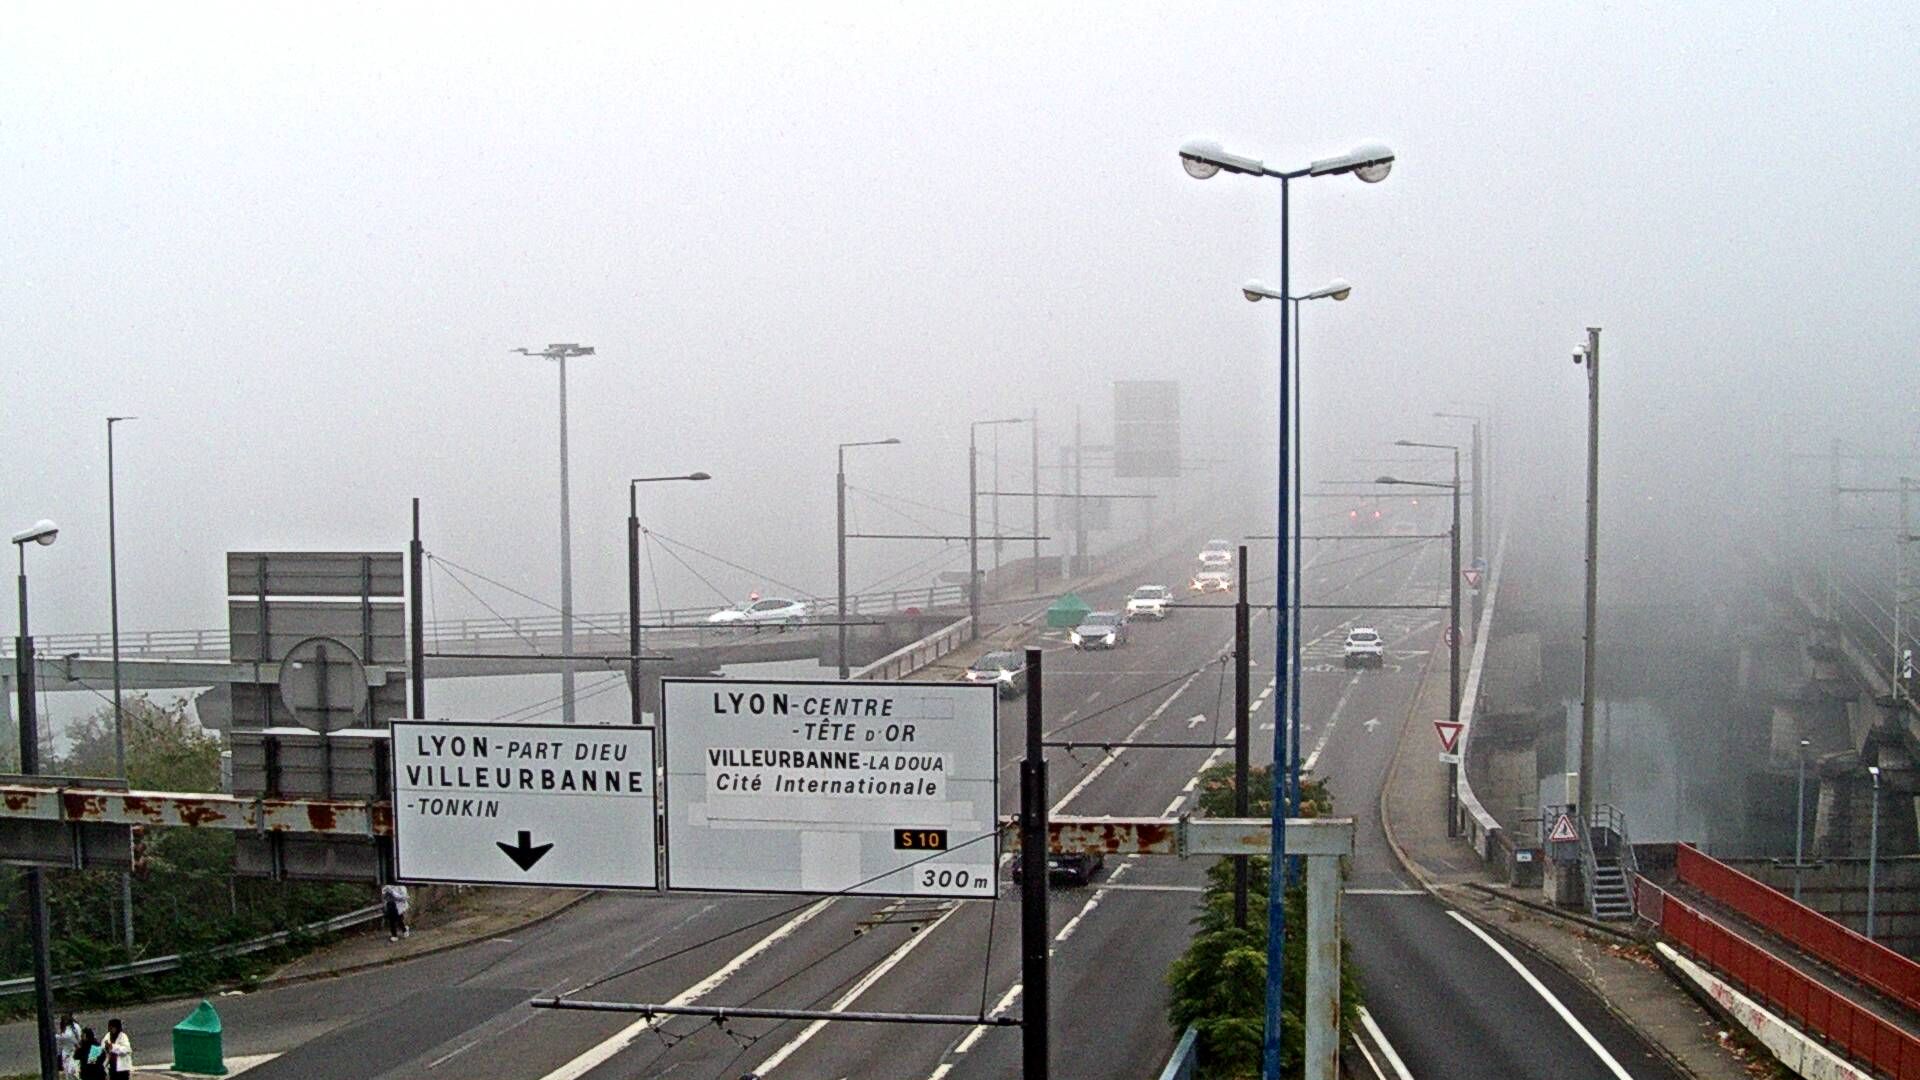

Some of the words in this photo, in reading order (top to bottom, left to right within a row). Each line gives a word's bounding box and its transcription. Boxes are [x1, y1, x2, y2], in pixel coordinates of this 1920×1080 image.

[574, 743, 628, 762] DIEU
[894, 756, 944, 772] DOUA
[406, 764, 643, 793] VILLEURBANNE
[716, 773, 762, 792] Cité
[775, 774, 937, 796] Internationale
[902, 832, 913, 847] S
[919, 832, 940, 847] 10
[922, 869, 970, 889] 300
[973, 878, 988, 889] m
